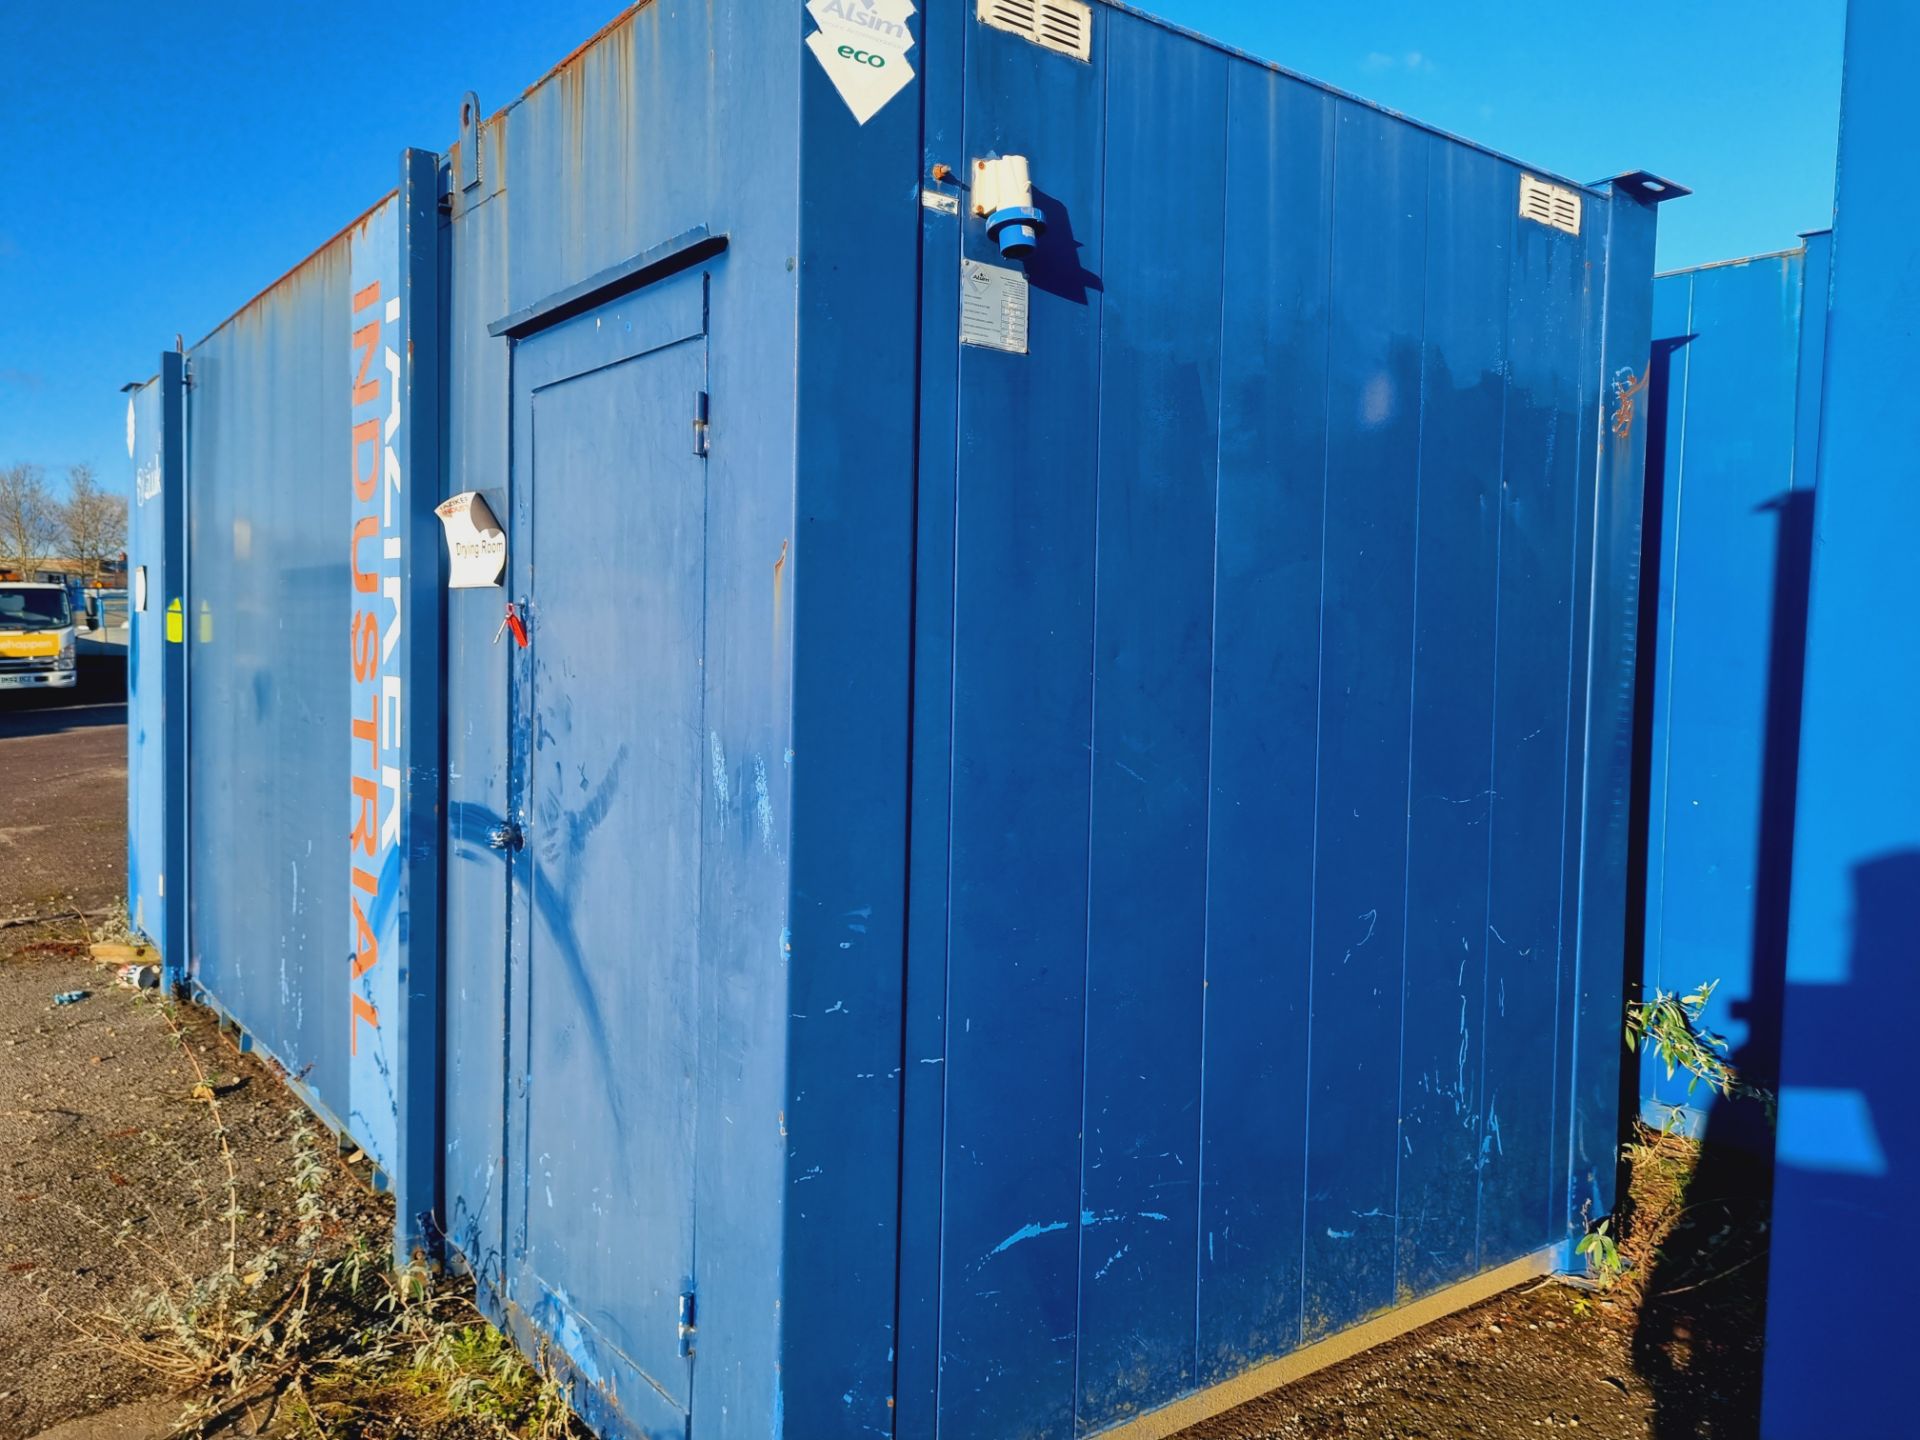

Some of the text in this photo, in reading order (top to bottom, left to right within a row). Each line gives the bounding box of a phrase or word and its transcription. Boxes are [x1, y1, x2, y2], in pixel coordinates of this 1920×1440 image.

[822, 0, 904, 38] Alsim
[837, 44, 886, 68] eco
[456, 540, 503, 558] Drying Room
[352, 280, 381, 1056] INDUSTRIAL
